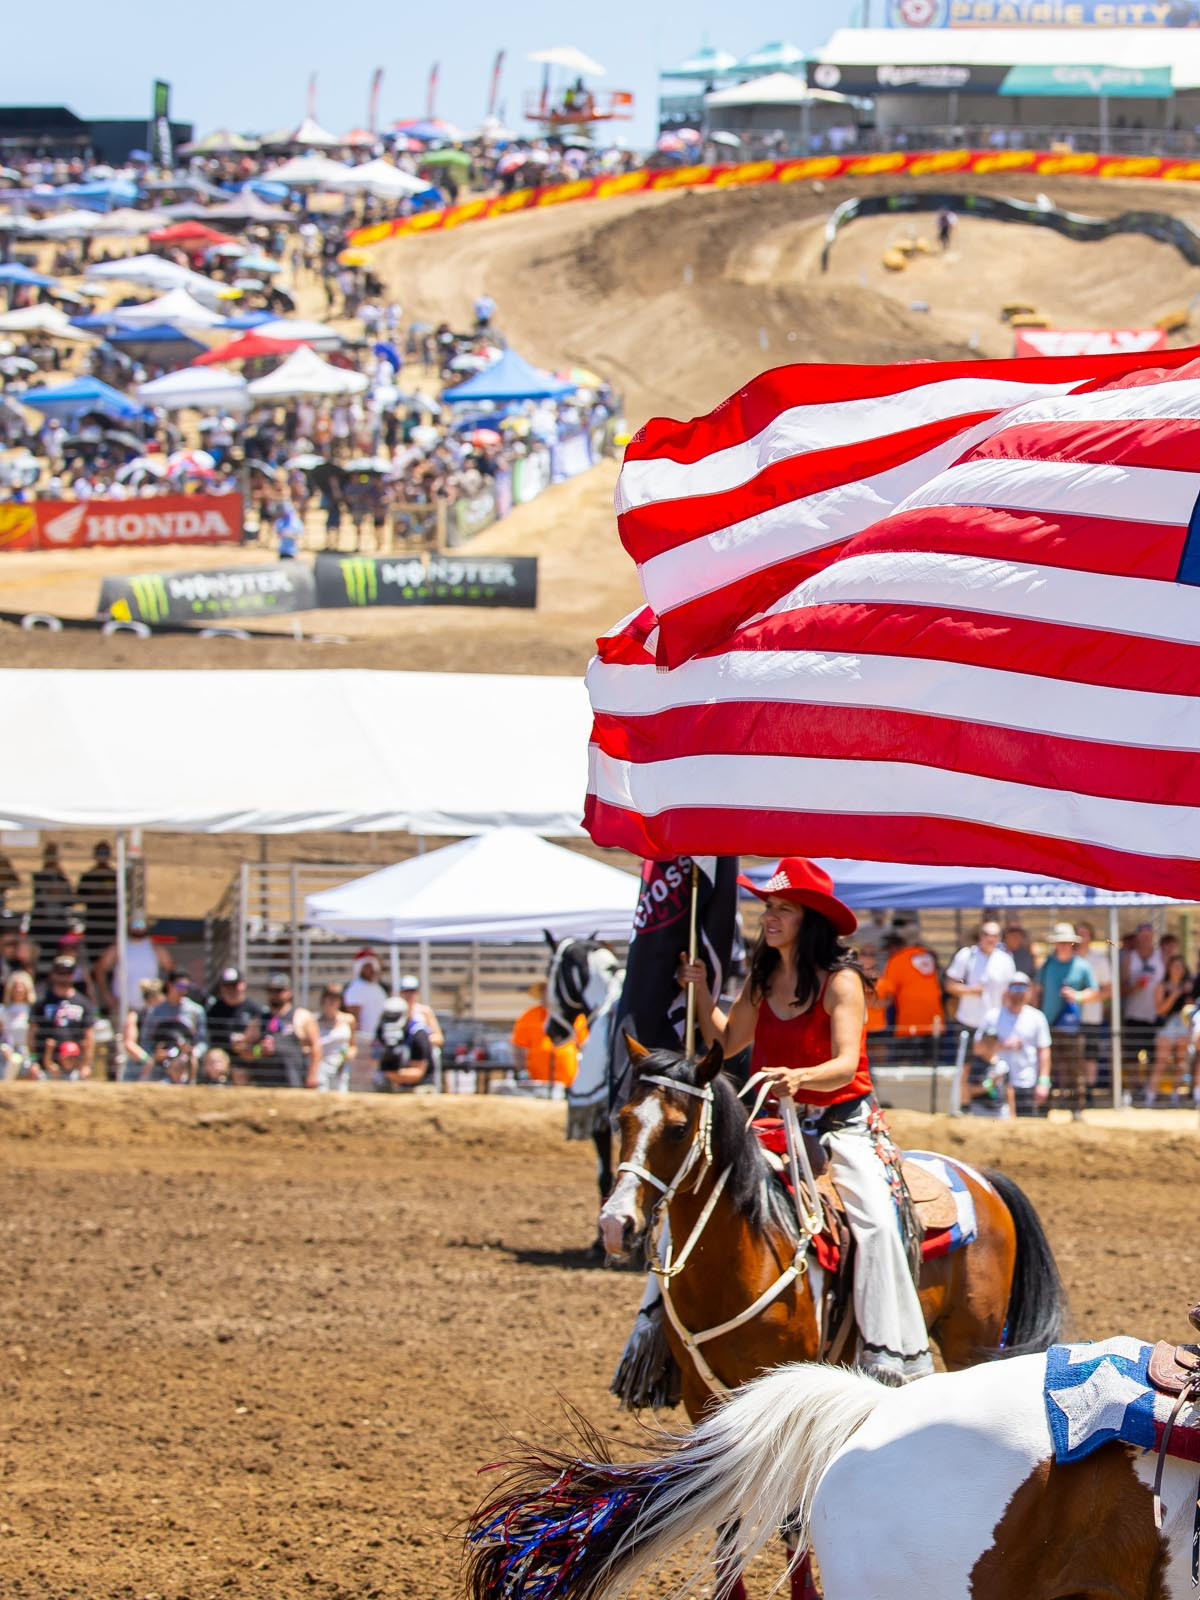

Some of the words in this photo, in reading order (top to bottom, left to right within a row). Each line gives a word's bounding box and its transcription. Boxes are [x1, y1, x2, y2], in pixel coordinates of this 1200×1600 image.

[1095, 3, 1172, 25] CITY
[86, 511, 230, 541] HONDA
[169, 571, 292, 600] MONSTER
[382, 560, 516, 586] MONSTER
